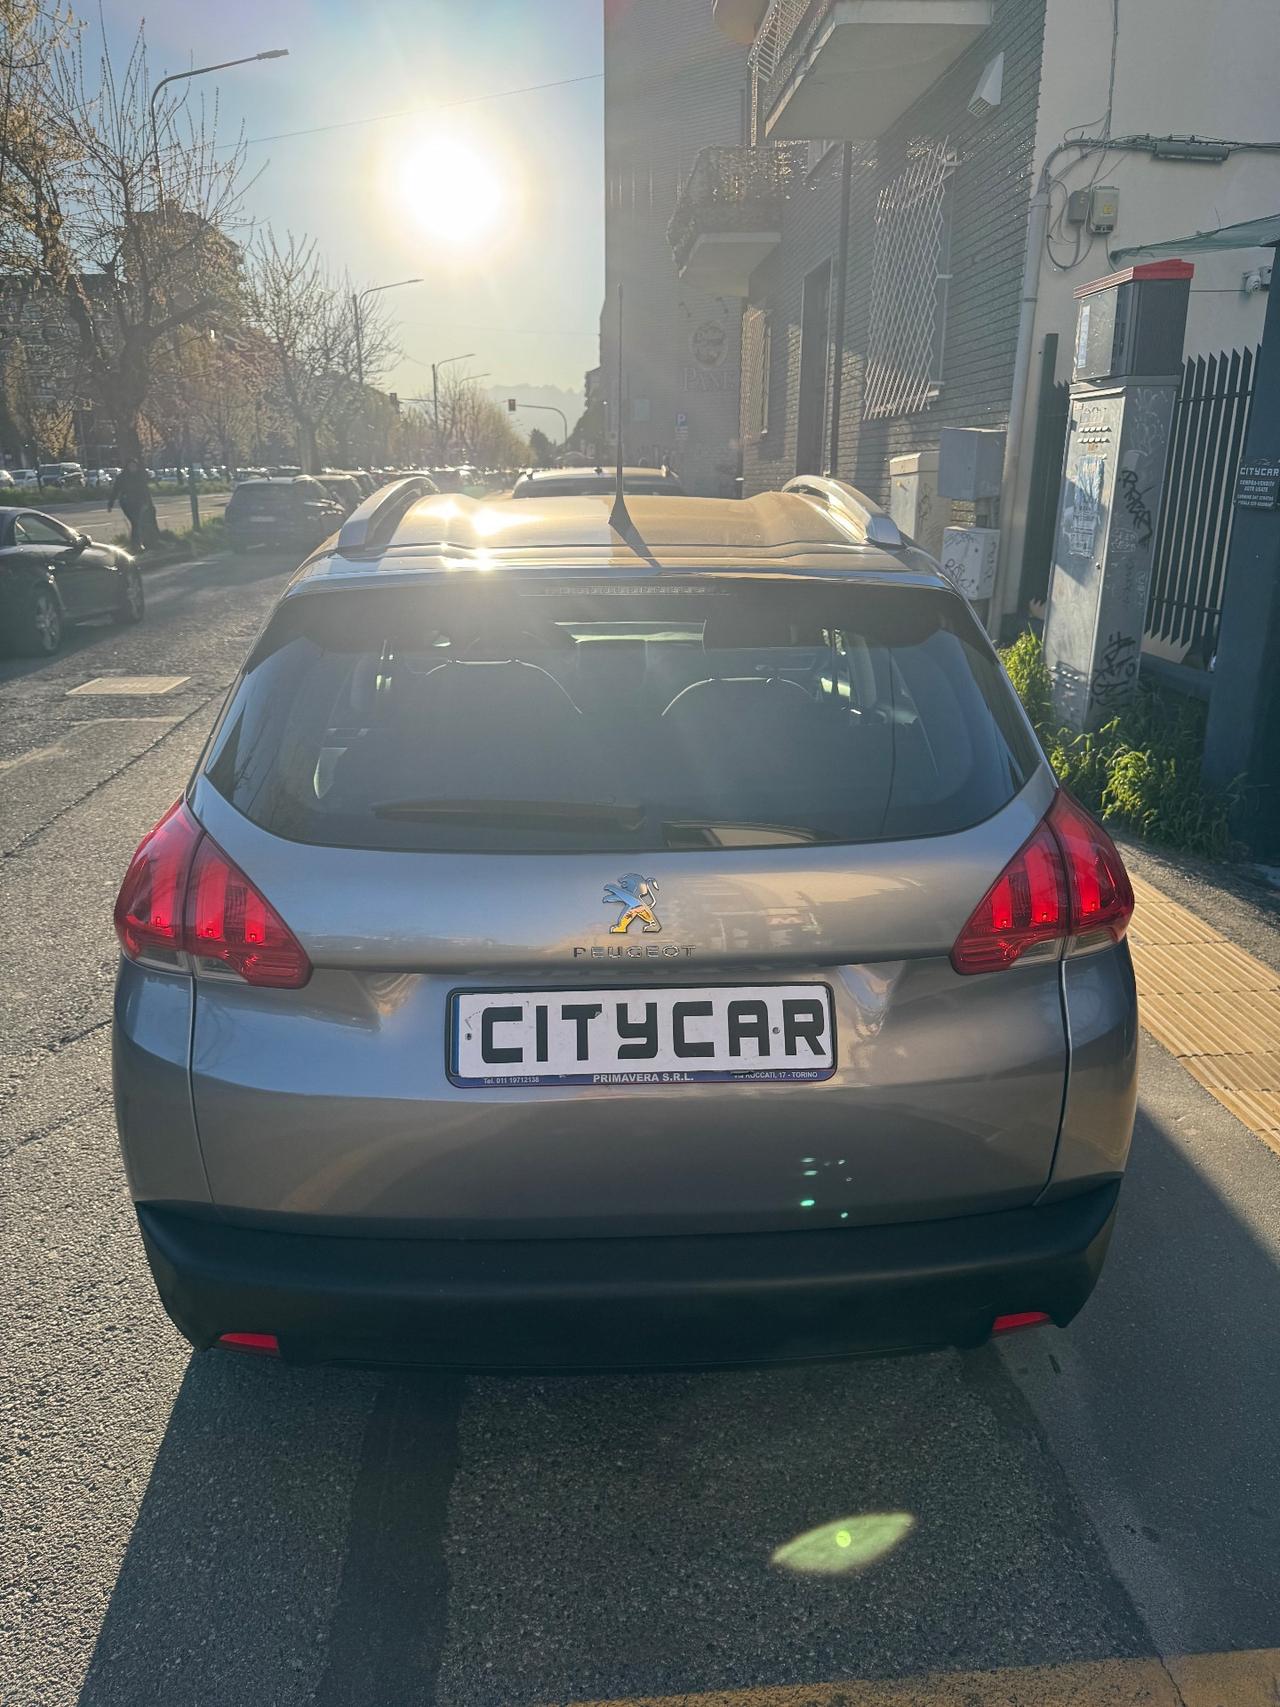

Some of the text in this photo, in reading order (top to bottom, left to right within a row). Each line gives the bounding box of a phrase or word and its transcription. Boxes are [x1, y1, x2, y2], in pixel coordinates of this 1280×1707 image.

[1240, 467, 1279, 476] CITYCAR
[573, 945, 697, 959] PEUGEOT
[481, 999, 826, 1063] CITYCAR
[593, 1072, 694, 1083] PRIMAVERA S.R.L.
